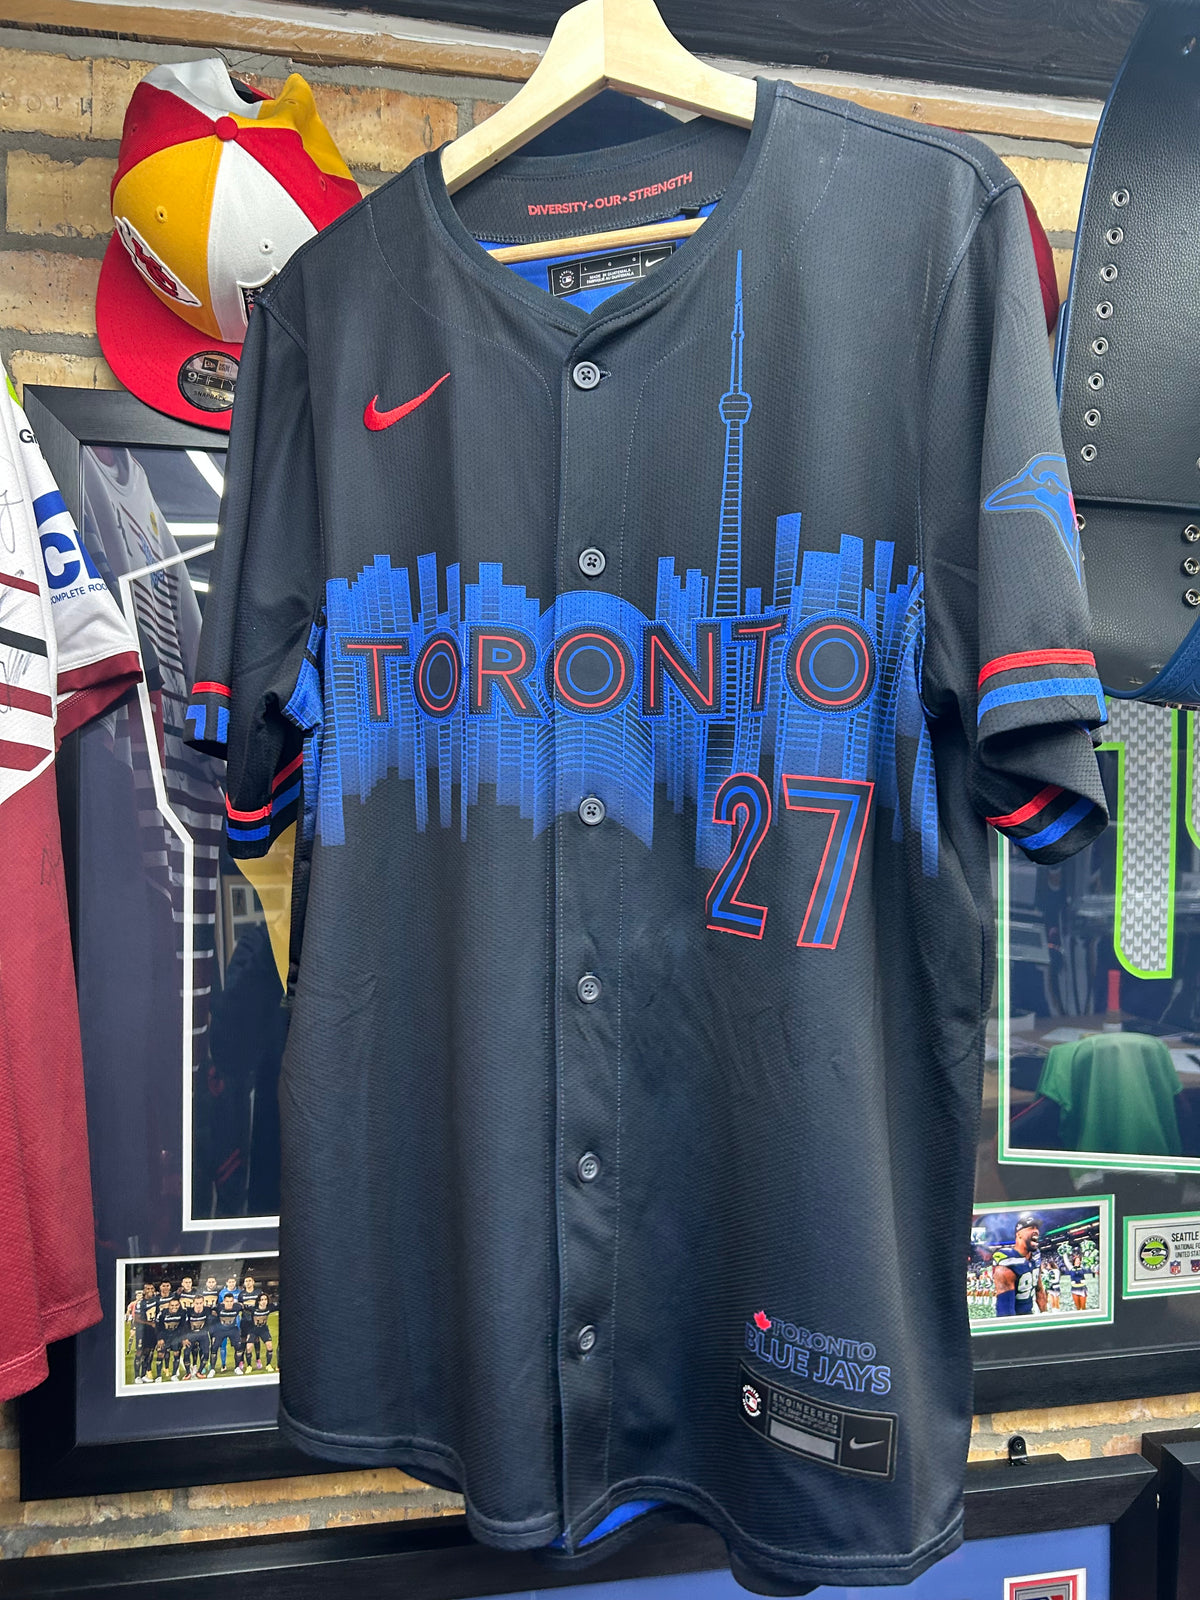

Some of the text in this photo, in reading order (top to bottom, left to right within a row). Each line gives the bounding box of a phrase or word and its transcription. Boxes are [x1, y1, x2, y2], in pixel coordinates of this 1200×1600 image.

[528, 171, 693, 216] DIVERSITY OUR STRENGTH
[50, 586, 86, 605] OMPLETE
[337, 611, 876, 726] TORONTO
[705, 772, 875, 950] 27
[1171, 1231, 1199, 1243] SEATTLE
[744, 1321, 891, 1395] BLUE JAYS
[771, 1317, 876, 1361] TORONTO
